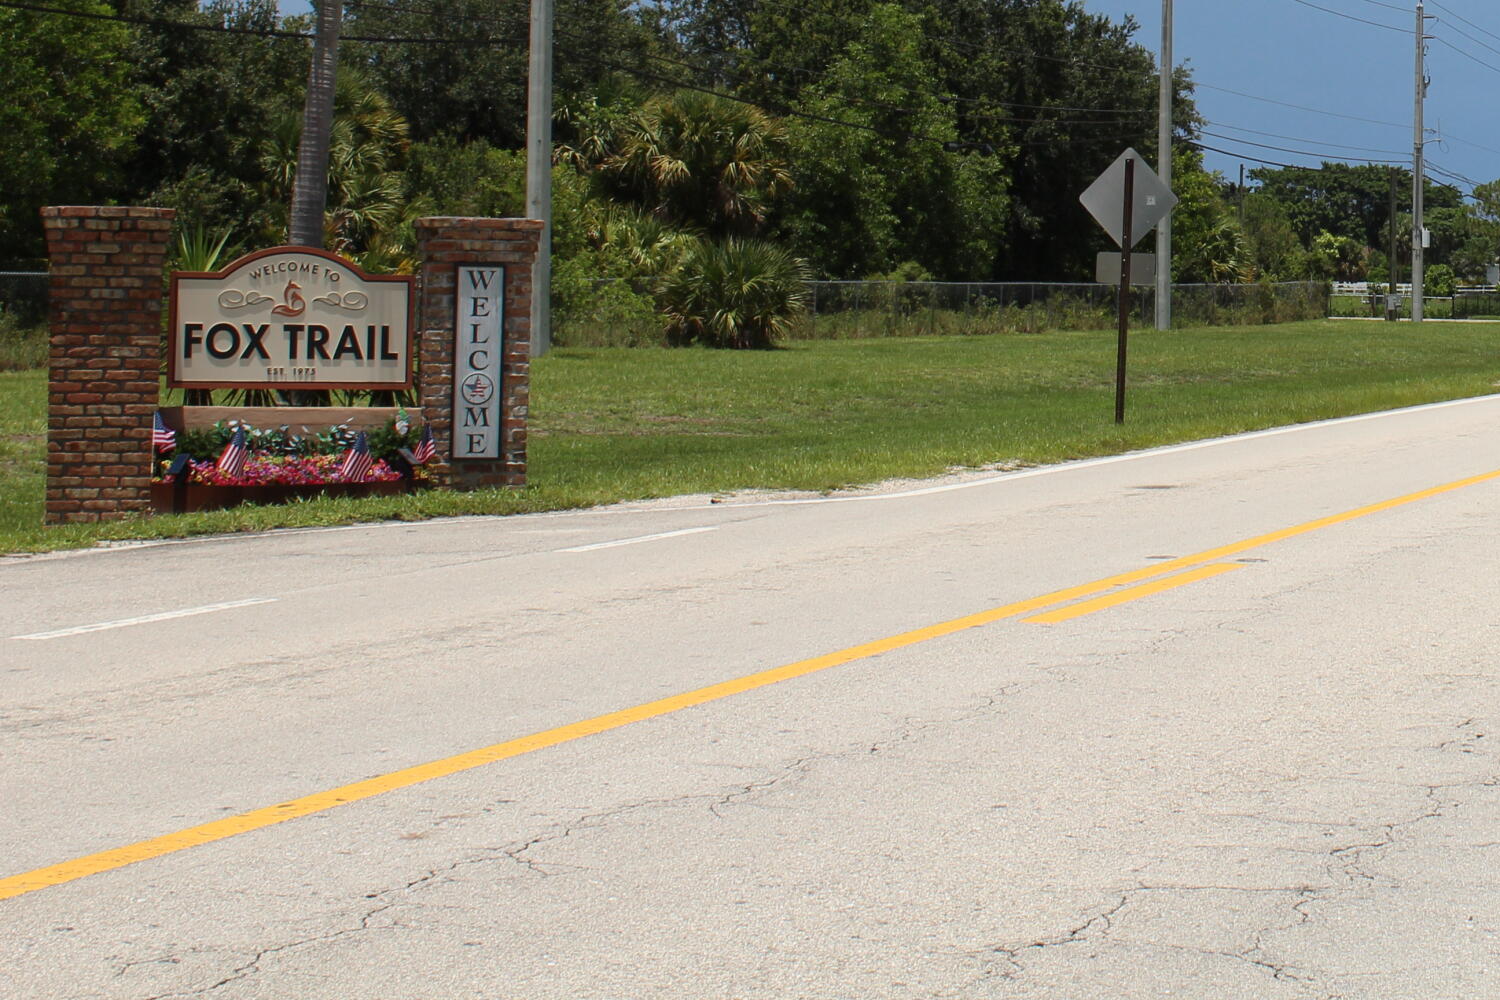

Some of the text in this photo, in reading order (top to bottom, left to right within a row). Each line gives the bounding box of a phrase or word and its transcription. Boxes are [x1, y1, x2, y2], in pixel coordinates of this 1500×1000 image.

[250, 262, 341, 283] WELCOME TO
[184, 323, 399, 361] FOX TRAIL
